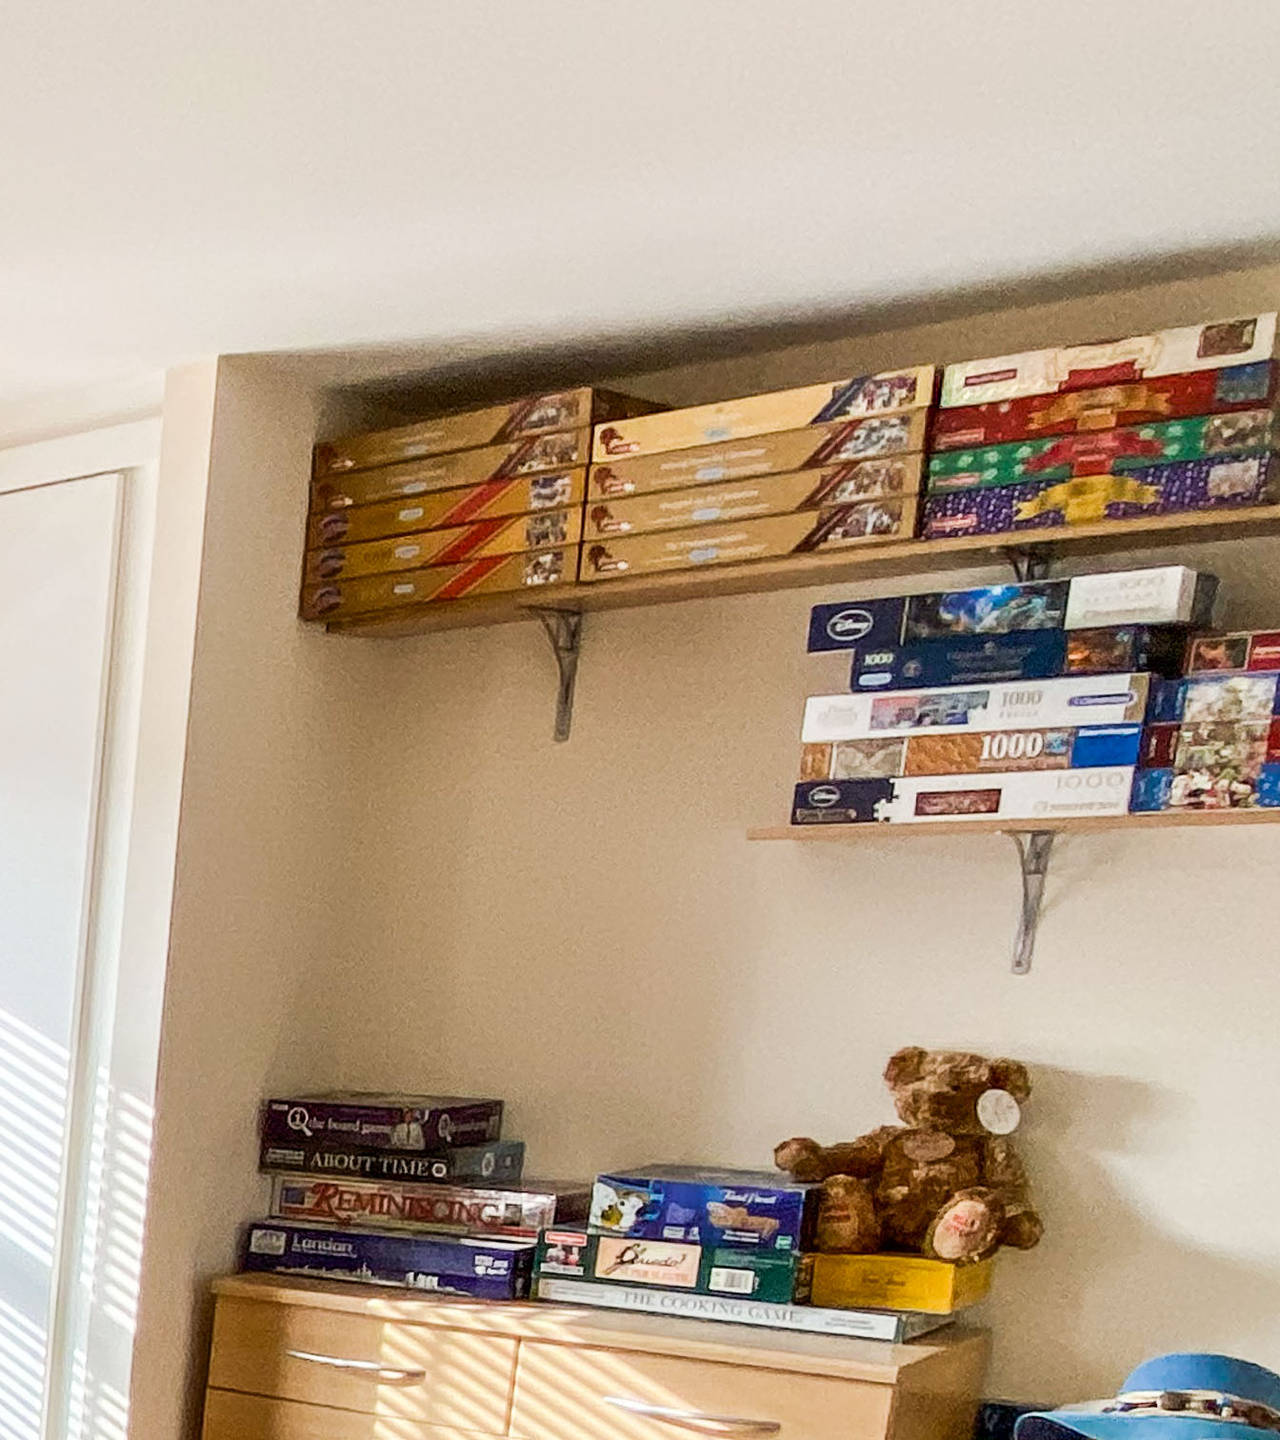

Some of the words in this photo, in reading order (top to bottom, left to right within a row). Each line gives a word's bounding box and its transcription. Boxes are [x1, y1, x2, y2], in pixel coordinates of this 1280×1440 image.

[979, 732, 1044, 761] 1000
[1055, 771, 1125, 790] 1000
[310, 1152, 376, 1172] ABOUT
[380, 1157, 429, 1177] TIME
[622, 1290, 655, 1308] THE
[659, 1296, 741, 1318] COOKING
[747, 1308, 803, 1324] GAME
